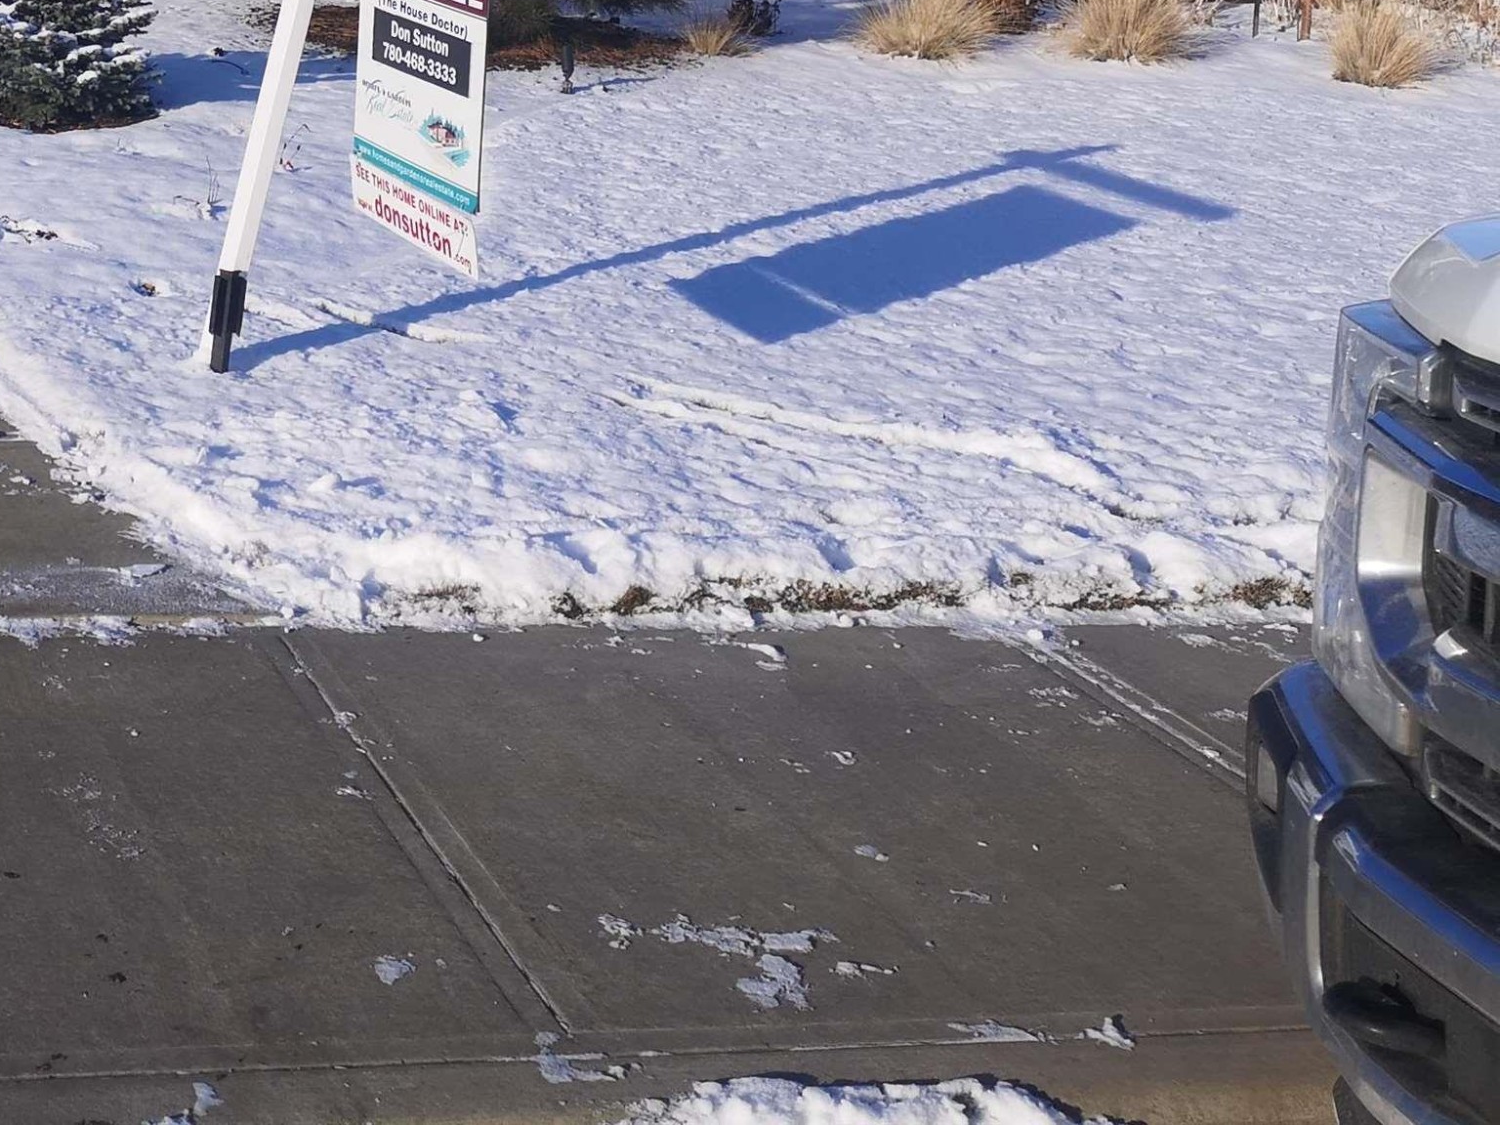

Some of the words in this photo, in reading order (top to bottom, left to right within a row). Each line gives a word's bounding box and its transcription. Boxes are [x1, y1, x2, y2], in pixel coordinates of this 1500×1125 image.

[391, 19, 411, 43] Don
[412, 29, 449, 57] Sutton
[400, 0, 429, 22] House
[431, 12, 468, 41] Doctor)
[382, 41, 457, 85] 780-468-3333
[356, 163, 371, 183] SEE
[371, 173, 391, 194] THIS
[392, 184, 417, 208] HOME
[418, 199, 451, 228] ONLINE
